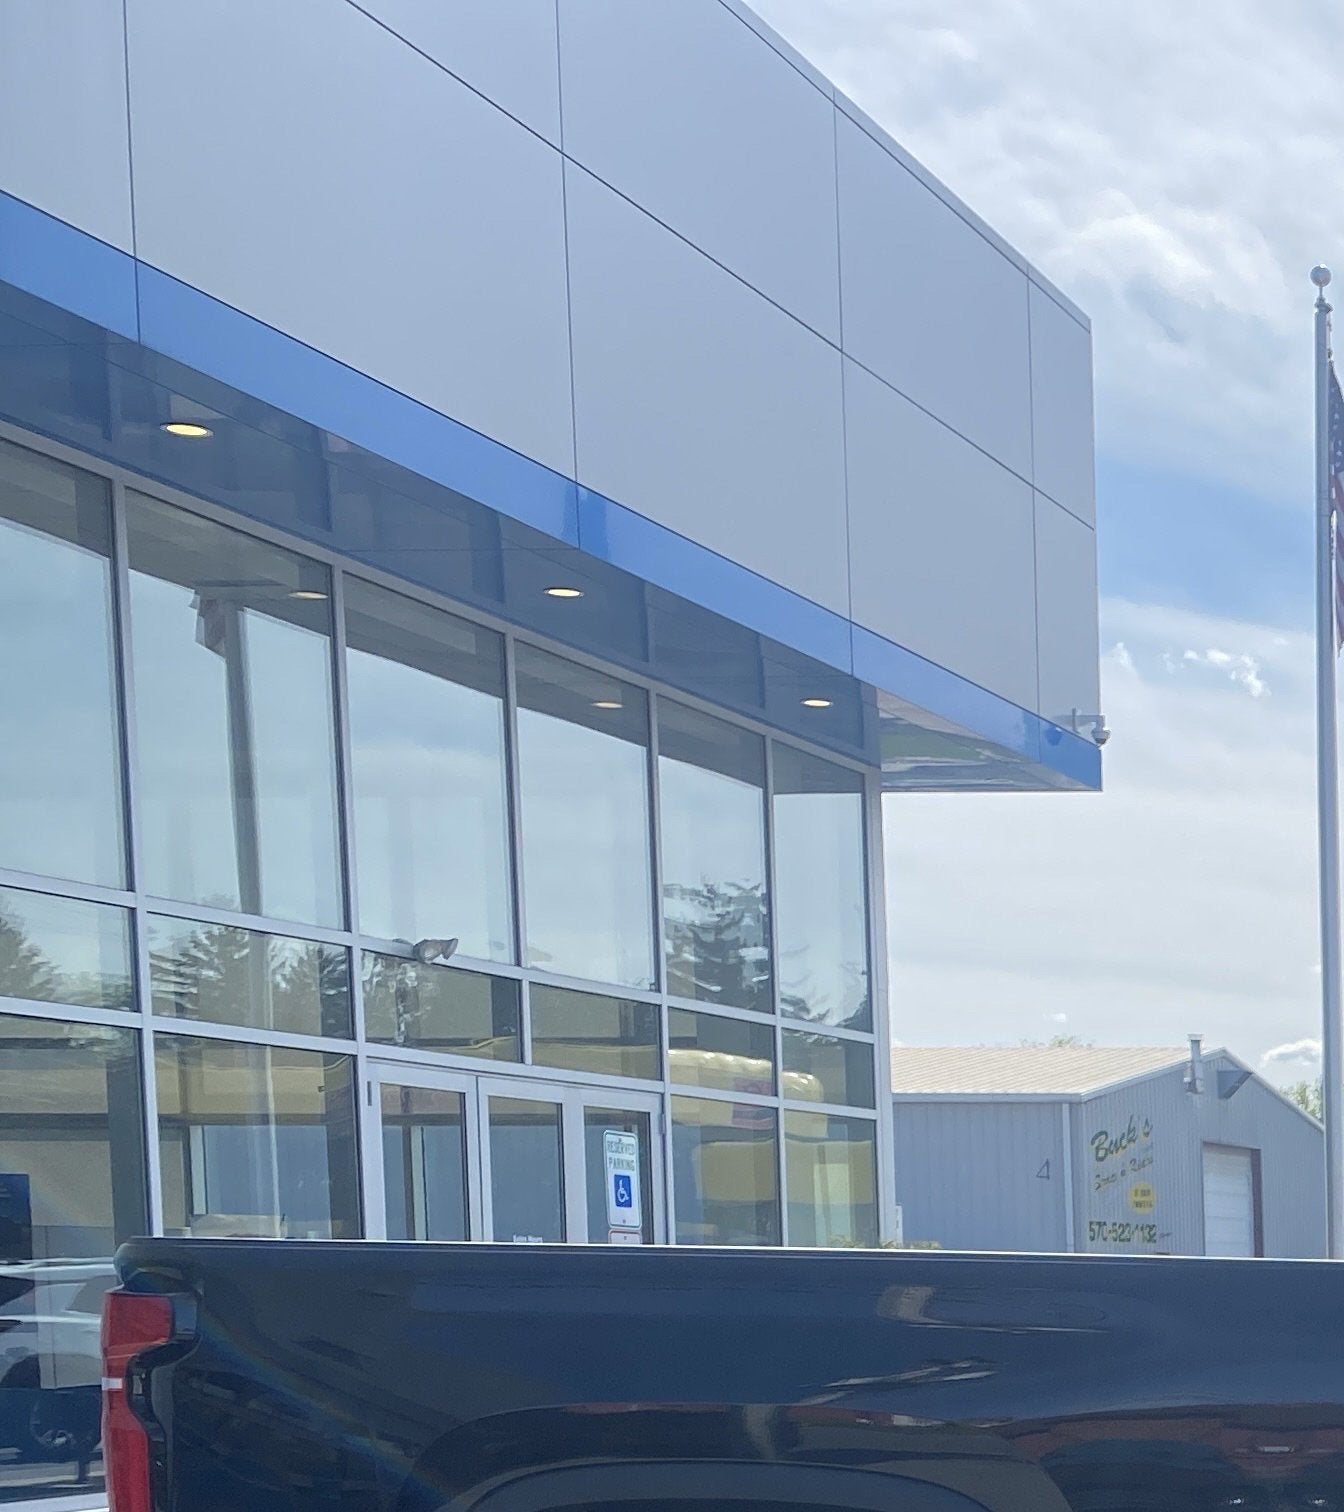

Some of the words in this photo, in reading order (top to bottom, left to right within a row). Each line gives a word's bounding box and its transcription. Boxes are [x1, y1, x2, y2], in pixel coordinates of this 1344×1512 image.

[1090, 1113, 1154, 1163] Buck's
[607, 1140, 635, 1156] RESERVED
[608, 1156, 635, 1172] PARKING
